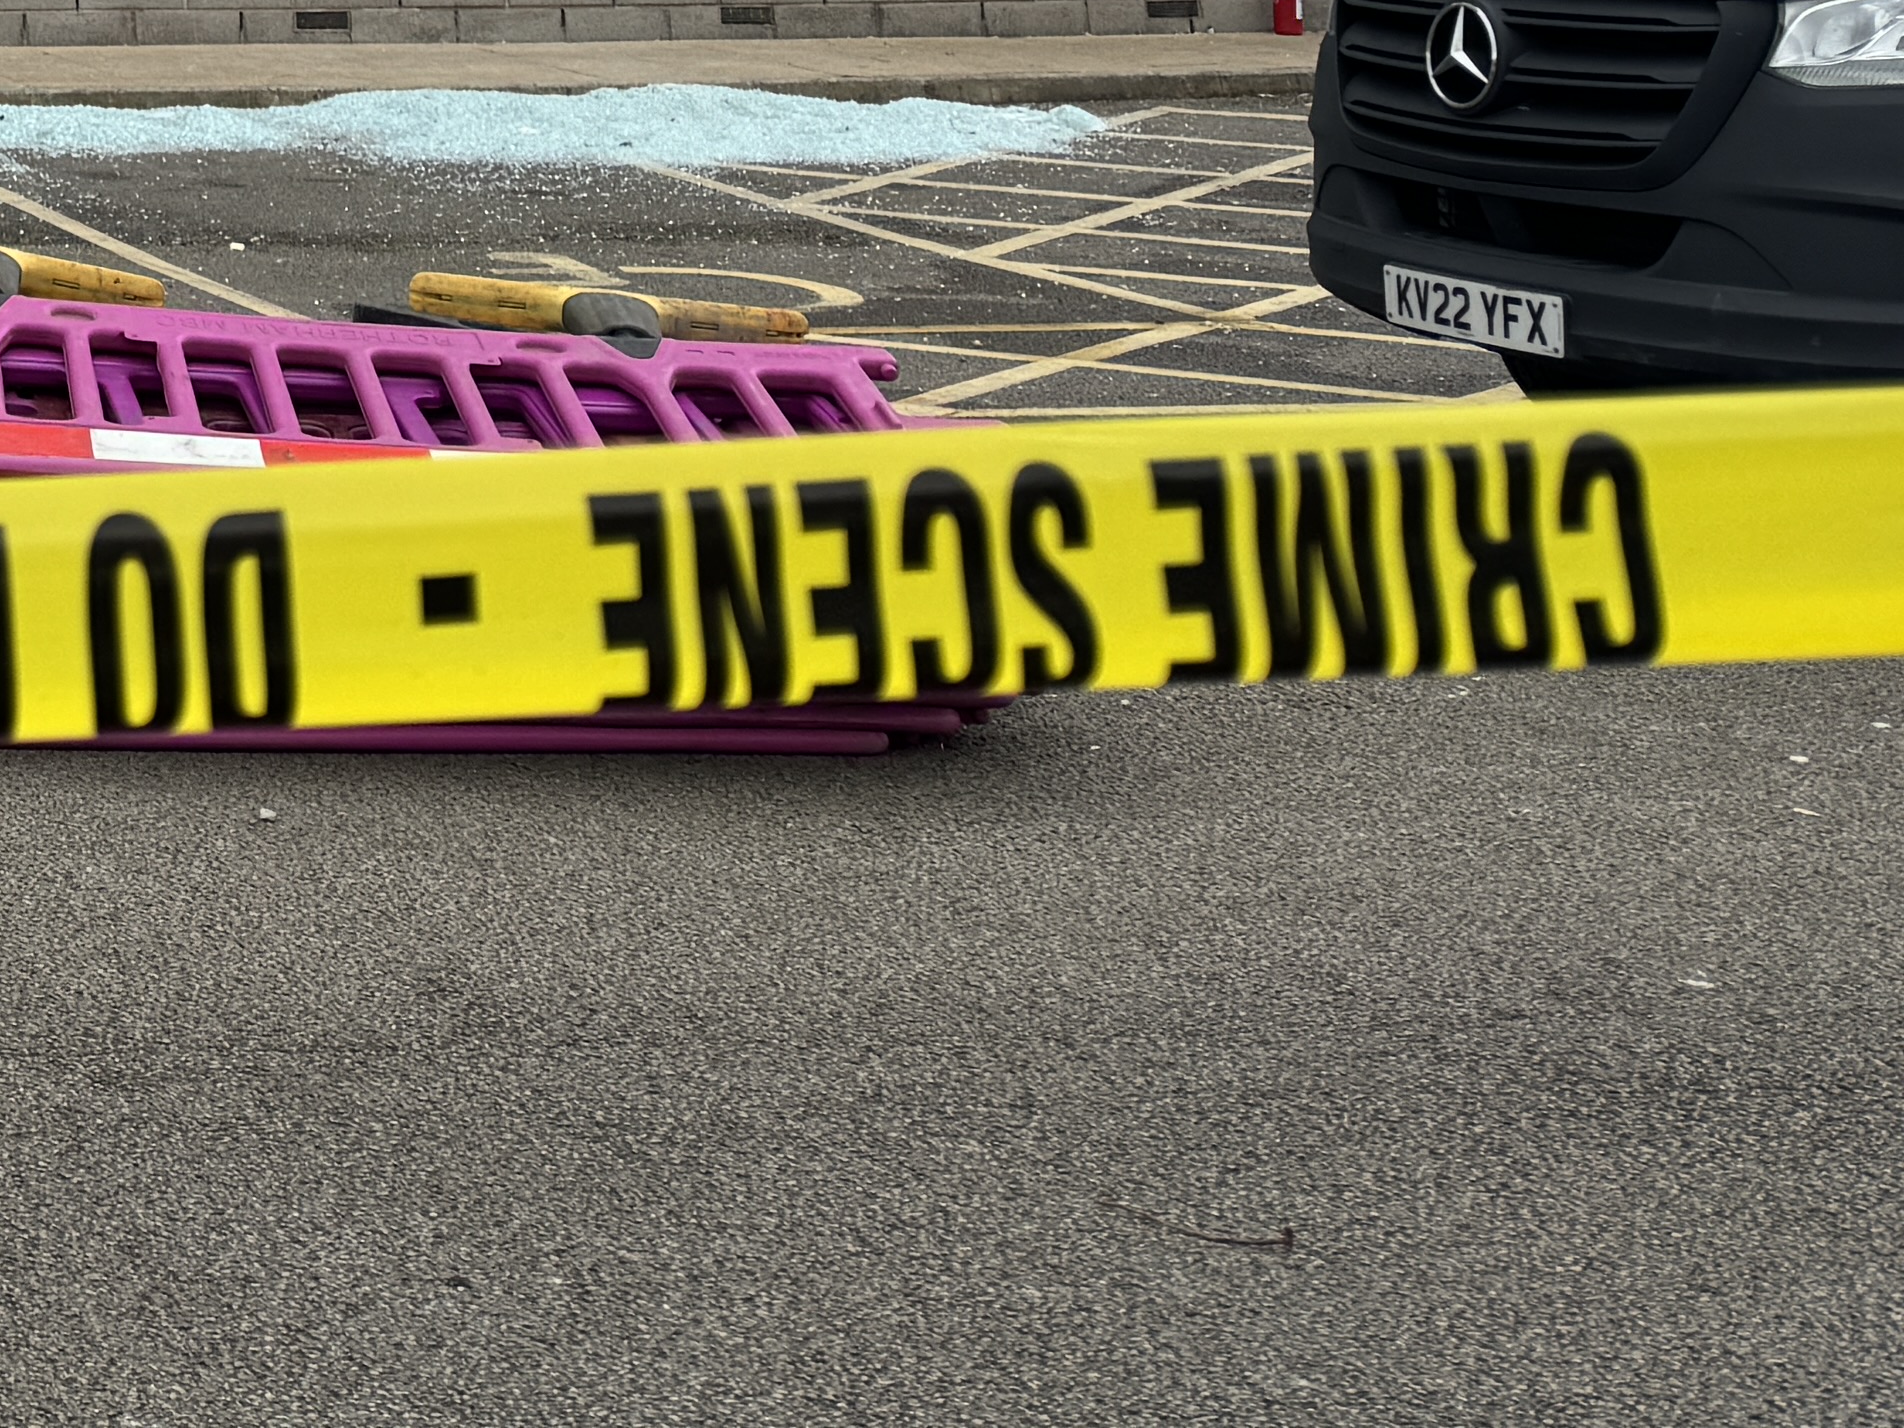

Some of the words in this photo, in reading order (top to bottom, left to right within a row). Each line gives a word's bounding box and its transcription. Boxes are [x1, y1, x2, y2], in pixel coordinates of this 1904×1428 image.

[1396, 273, 1473, 332] KV22
[1480, 290, 1548, 347] YFX
[85, 510, 298, 736] DO
[587, 461, 1104, 710] SCENE
[1150, 433, 1669, 684] CRIME
